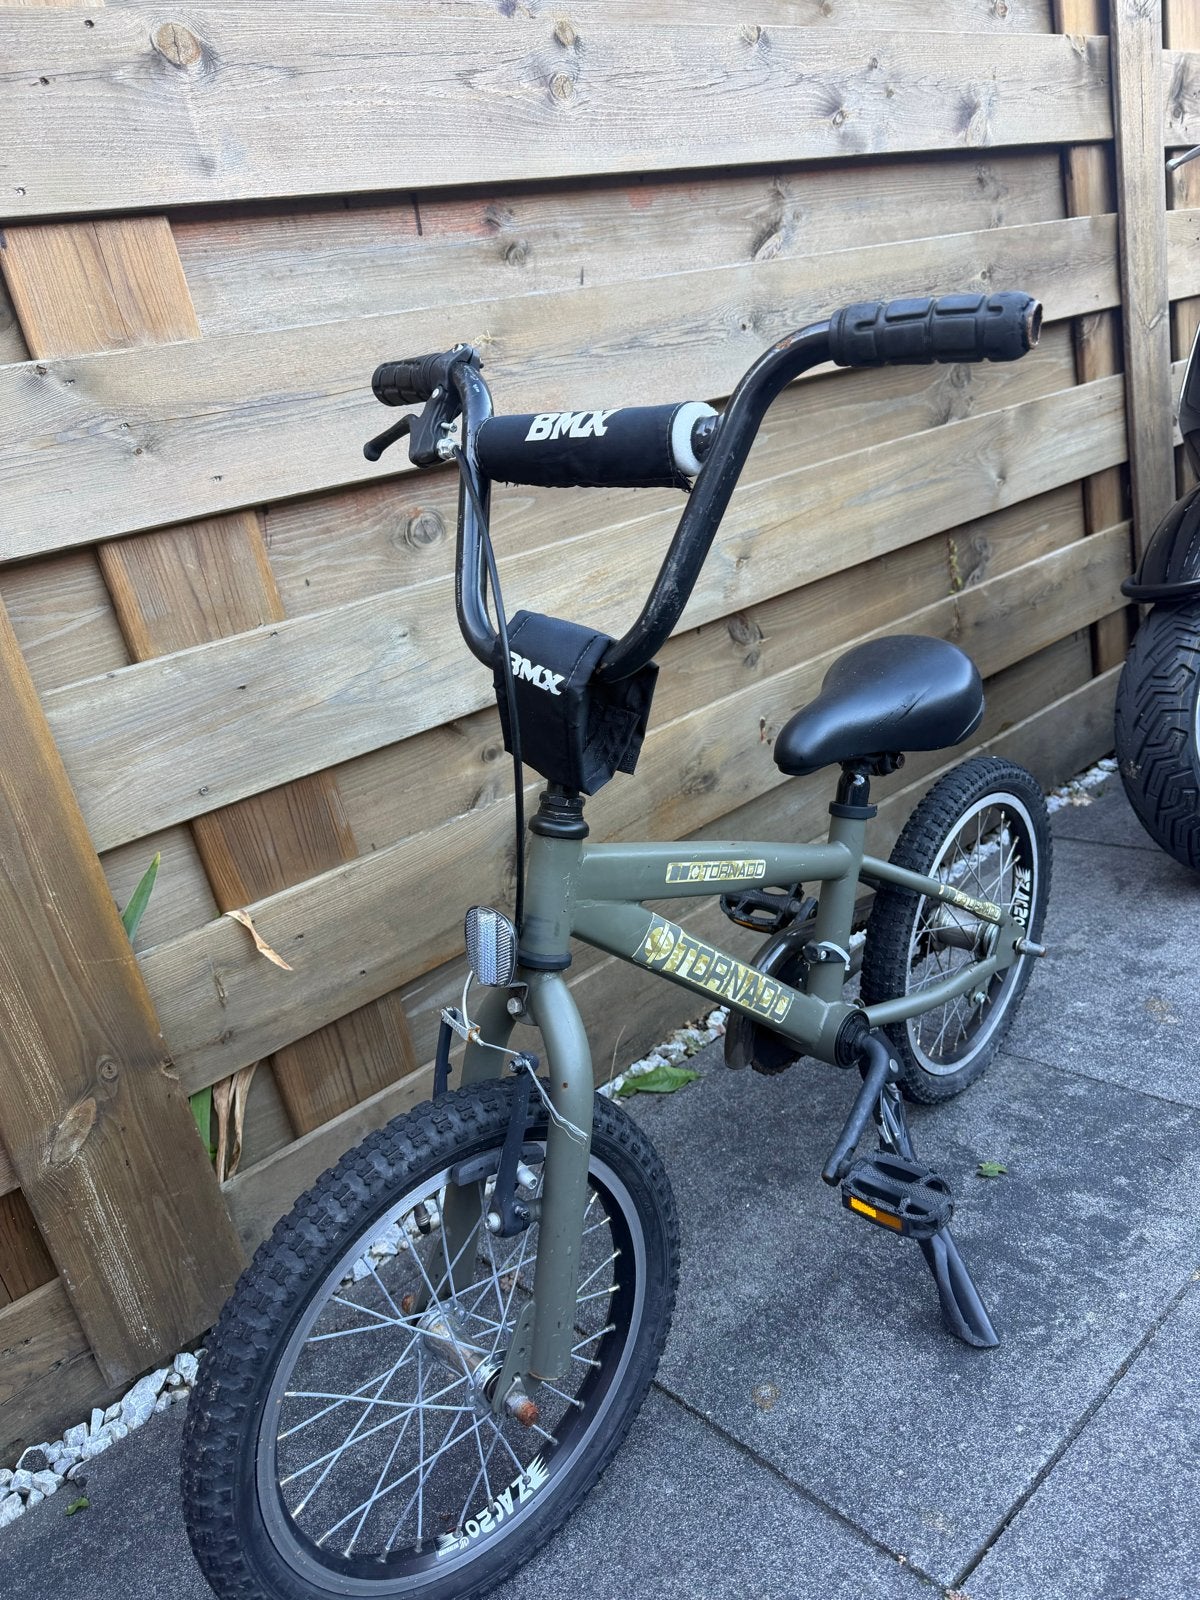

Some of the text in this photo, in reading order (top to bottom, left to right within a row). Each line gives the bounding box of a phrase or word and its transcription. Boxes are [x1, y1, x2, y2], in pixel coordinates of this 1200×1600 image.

[524, 408, 624, 442] BMX
[701, 861, 765, 879] TORNADO
[675, 935, 794, 1023] TORNADO
[465, 1472, 535, 1538] ZAC20
